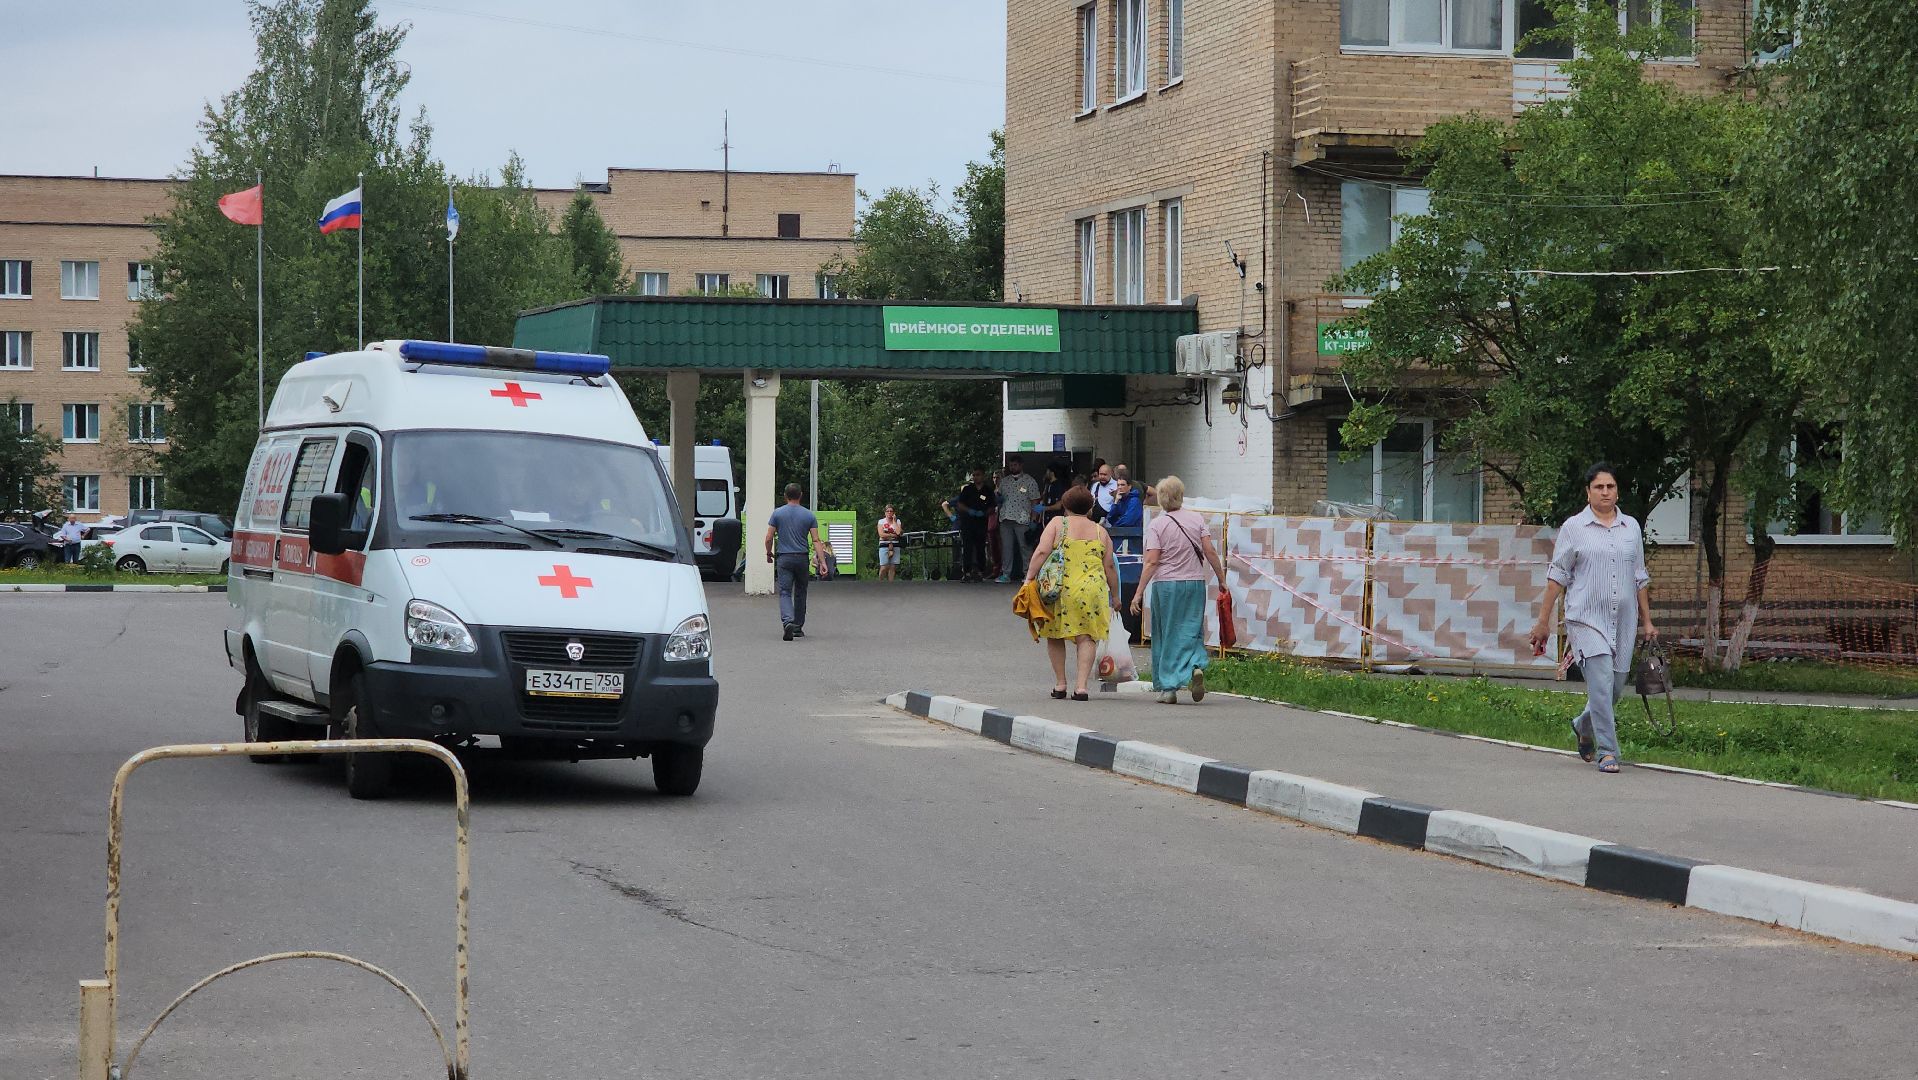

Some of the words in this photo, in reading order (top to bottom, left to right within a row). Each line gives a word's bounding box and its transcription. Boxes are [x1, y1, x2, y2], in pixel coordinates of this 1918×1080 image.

[889, 321, 967, 334] ПРИЁМНОЕ
[970, 323, 1054, 337] ОТДЕЛЕНИЕ
[597, 674, 620, 686] 750
